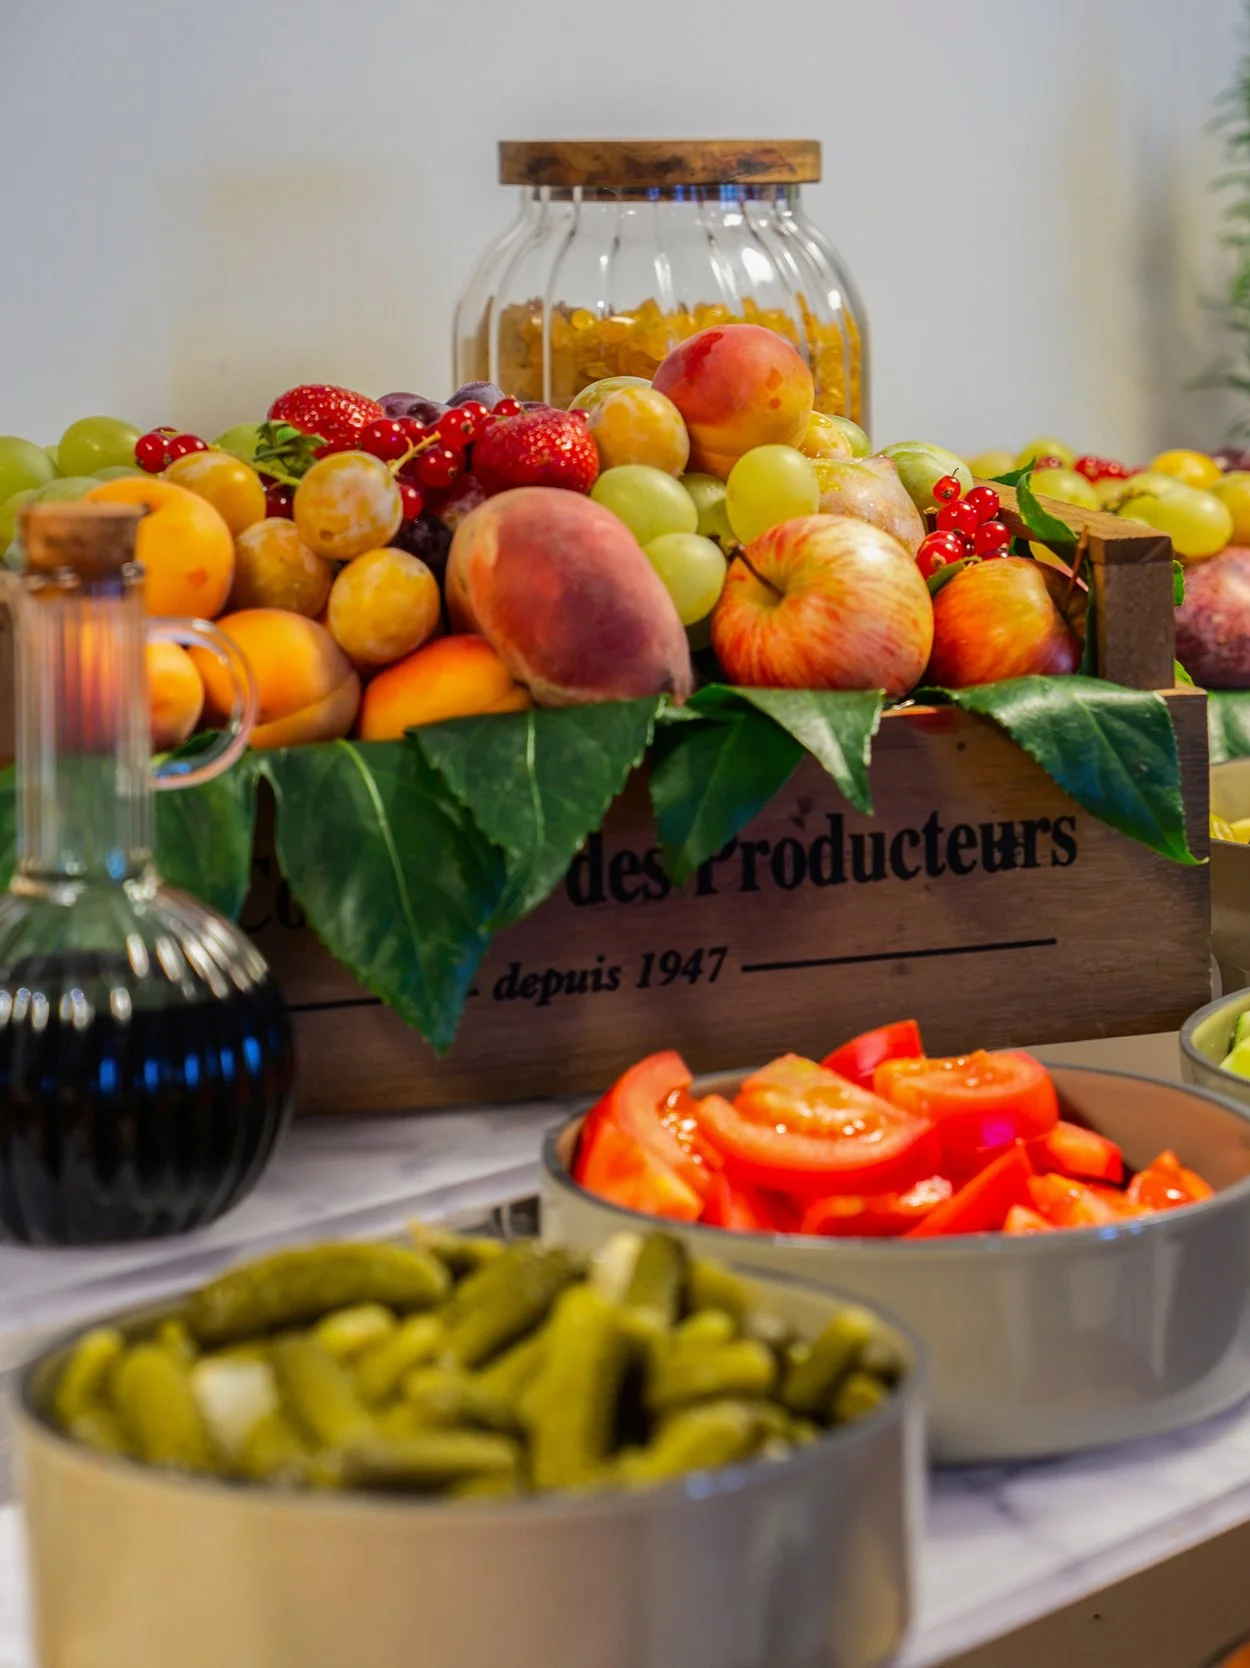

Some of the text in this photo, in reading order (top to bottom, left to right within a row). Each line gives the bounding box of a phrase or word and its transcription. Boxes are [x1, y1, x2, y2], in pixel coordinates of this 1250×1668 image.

[565, 831, 671, 907] des
[493, 946, 728, 1007] depuis 1947
